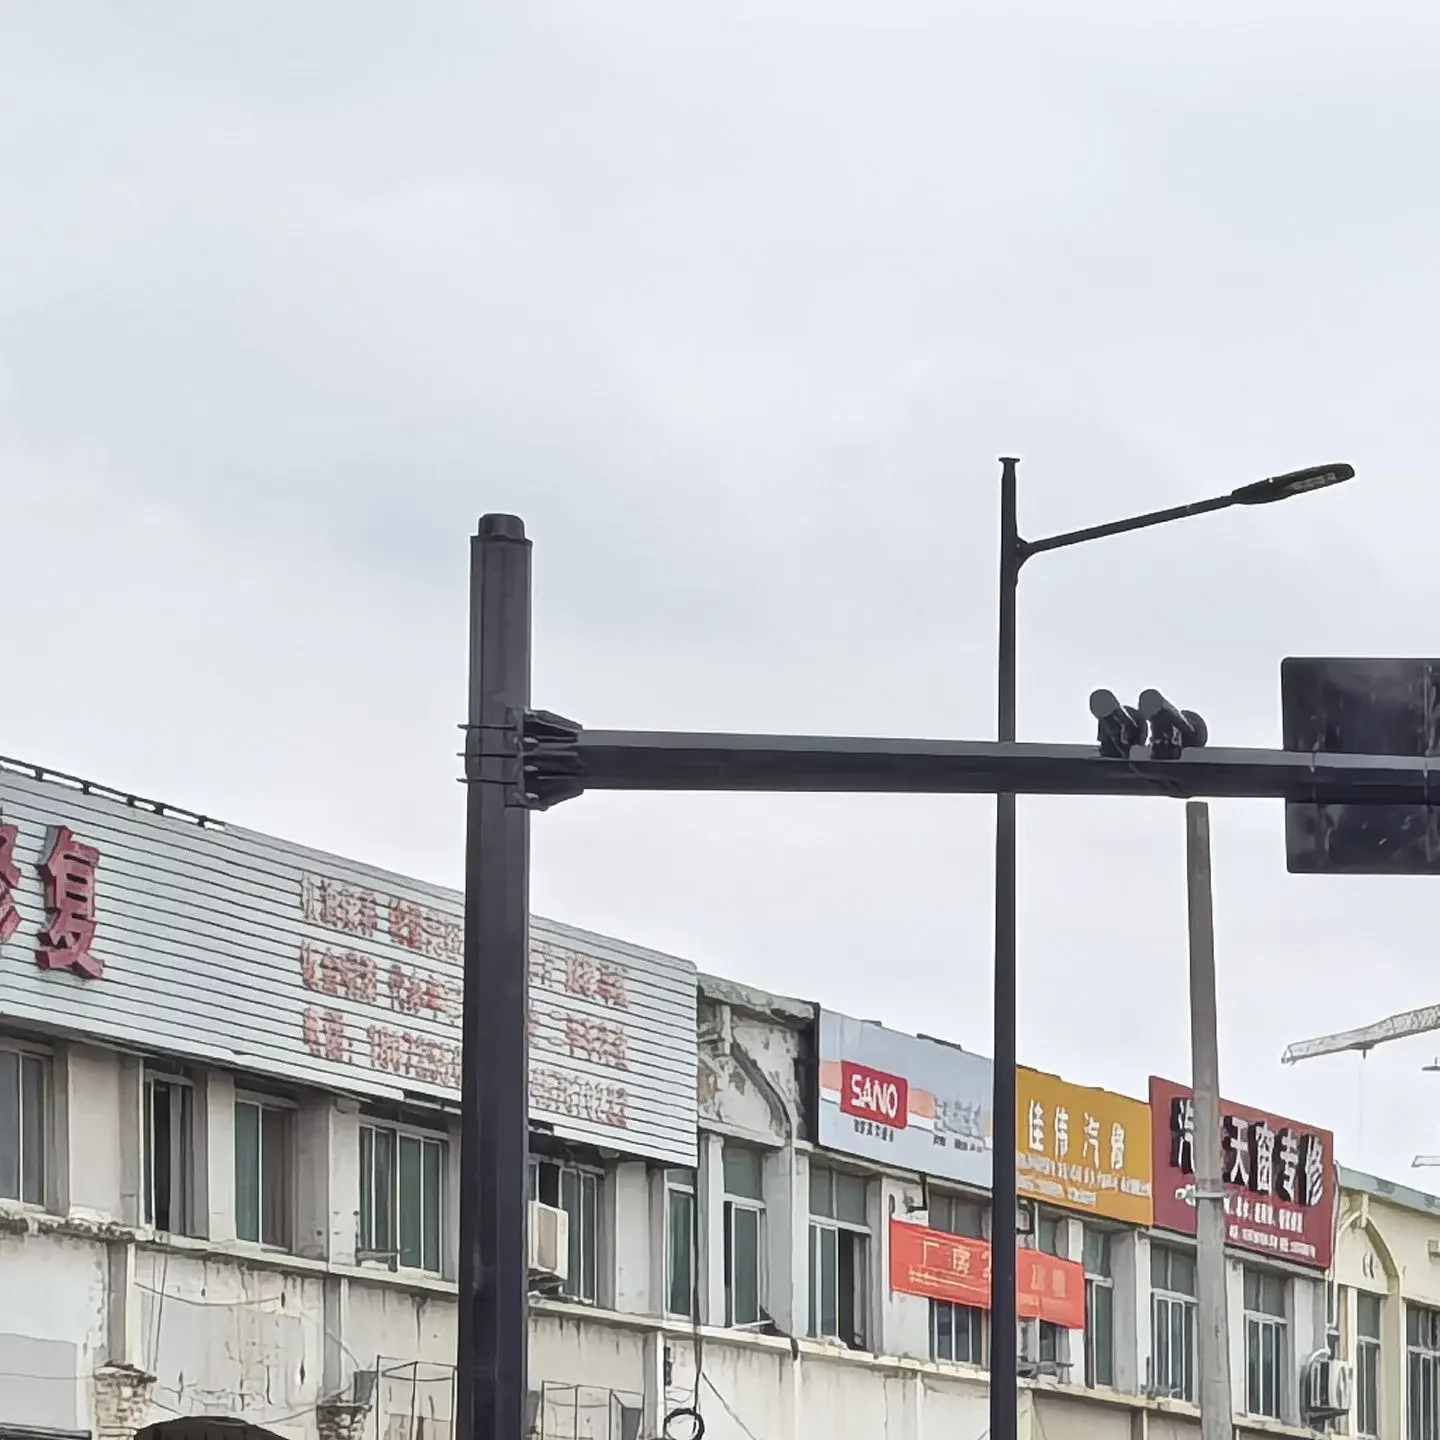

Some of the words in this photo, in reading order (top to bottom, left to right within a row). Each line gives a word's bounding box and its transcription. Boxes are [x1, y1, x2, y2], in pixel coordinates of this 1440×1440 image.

[851, 1073, 898, 1119] SANO
[1178, 1099, 1323, 1207] 汽天窗专修
